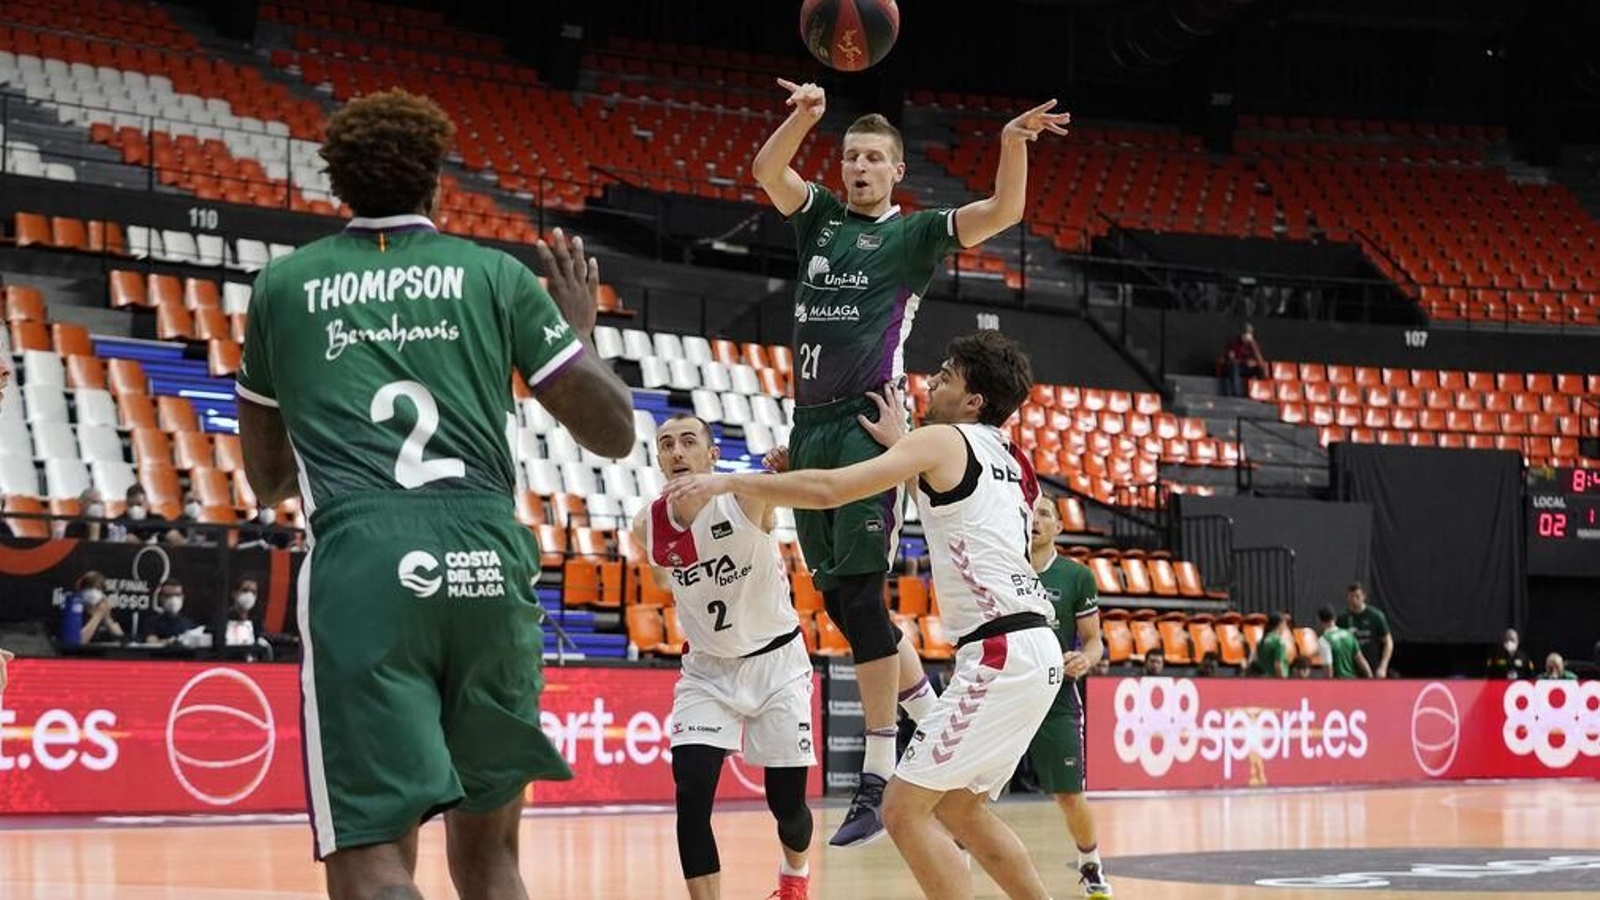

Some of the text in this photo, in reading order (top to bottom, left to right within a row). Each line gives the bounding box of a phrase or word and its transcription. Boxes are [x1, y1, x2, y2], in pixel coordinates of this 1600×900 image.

[189, 207, 218, 230] 110
[303, 265, 464, 313] THOMPSON
[1405, 330, 1428, 347] 107
[800, 343, 822, 379] 21
[370, 380, 466, 490] 2
[1533, 495, 1567, 509] LOCAL
[1539, 513, 1567, 537] 02
[445, 550, 502, 568] COSTA
[447, 567, 504, 583] DEL SOL
[707, 600, 732, 632] 2
